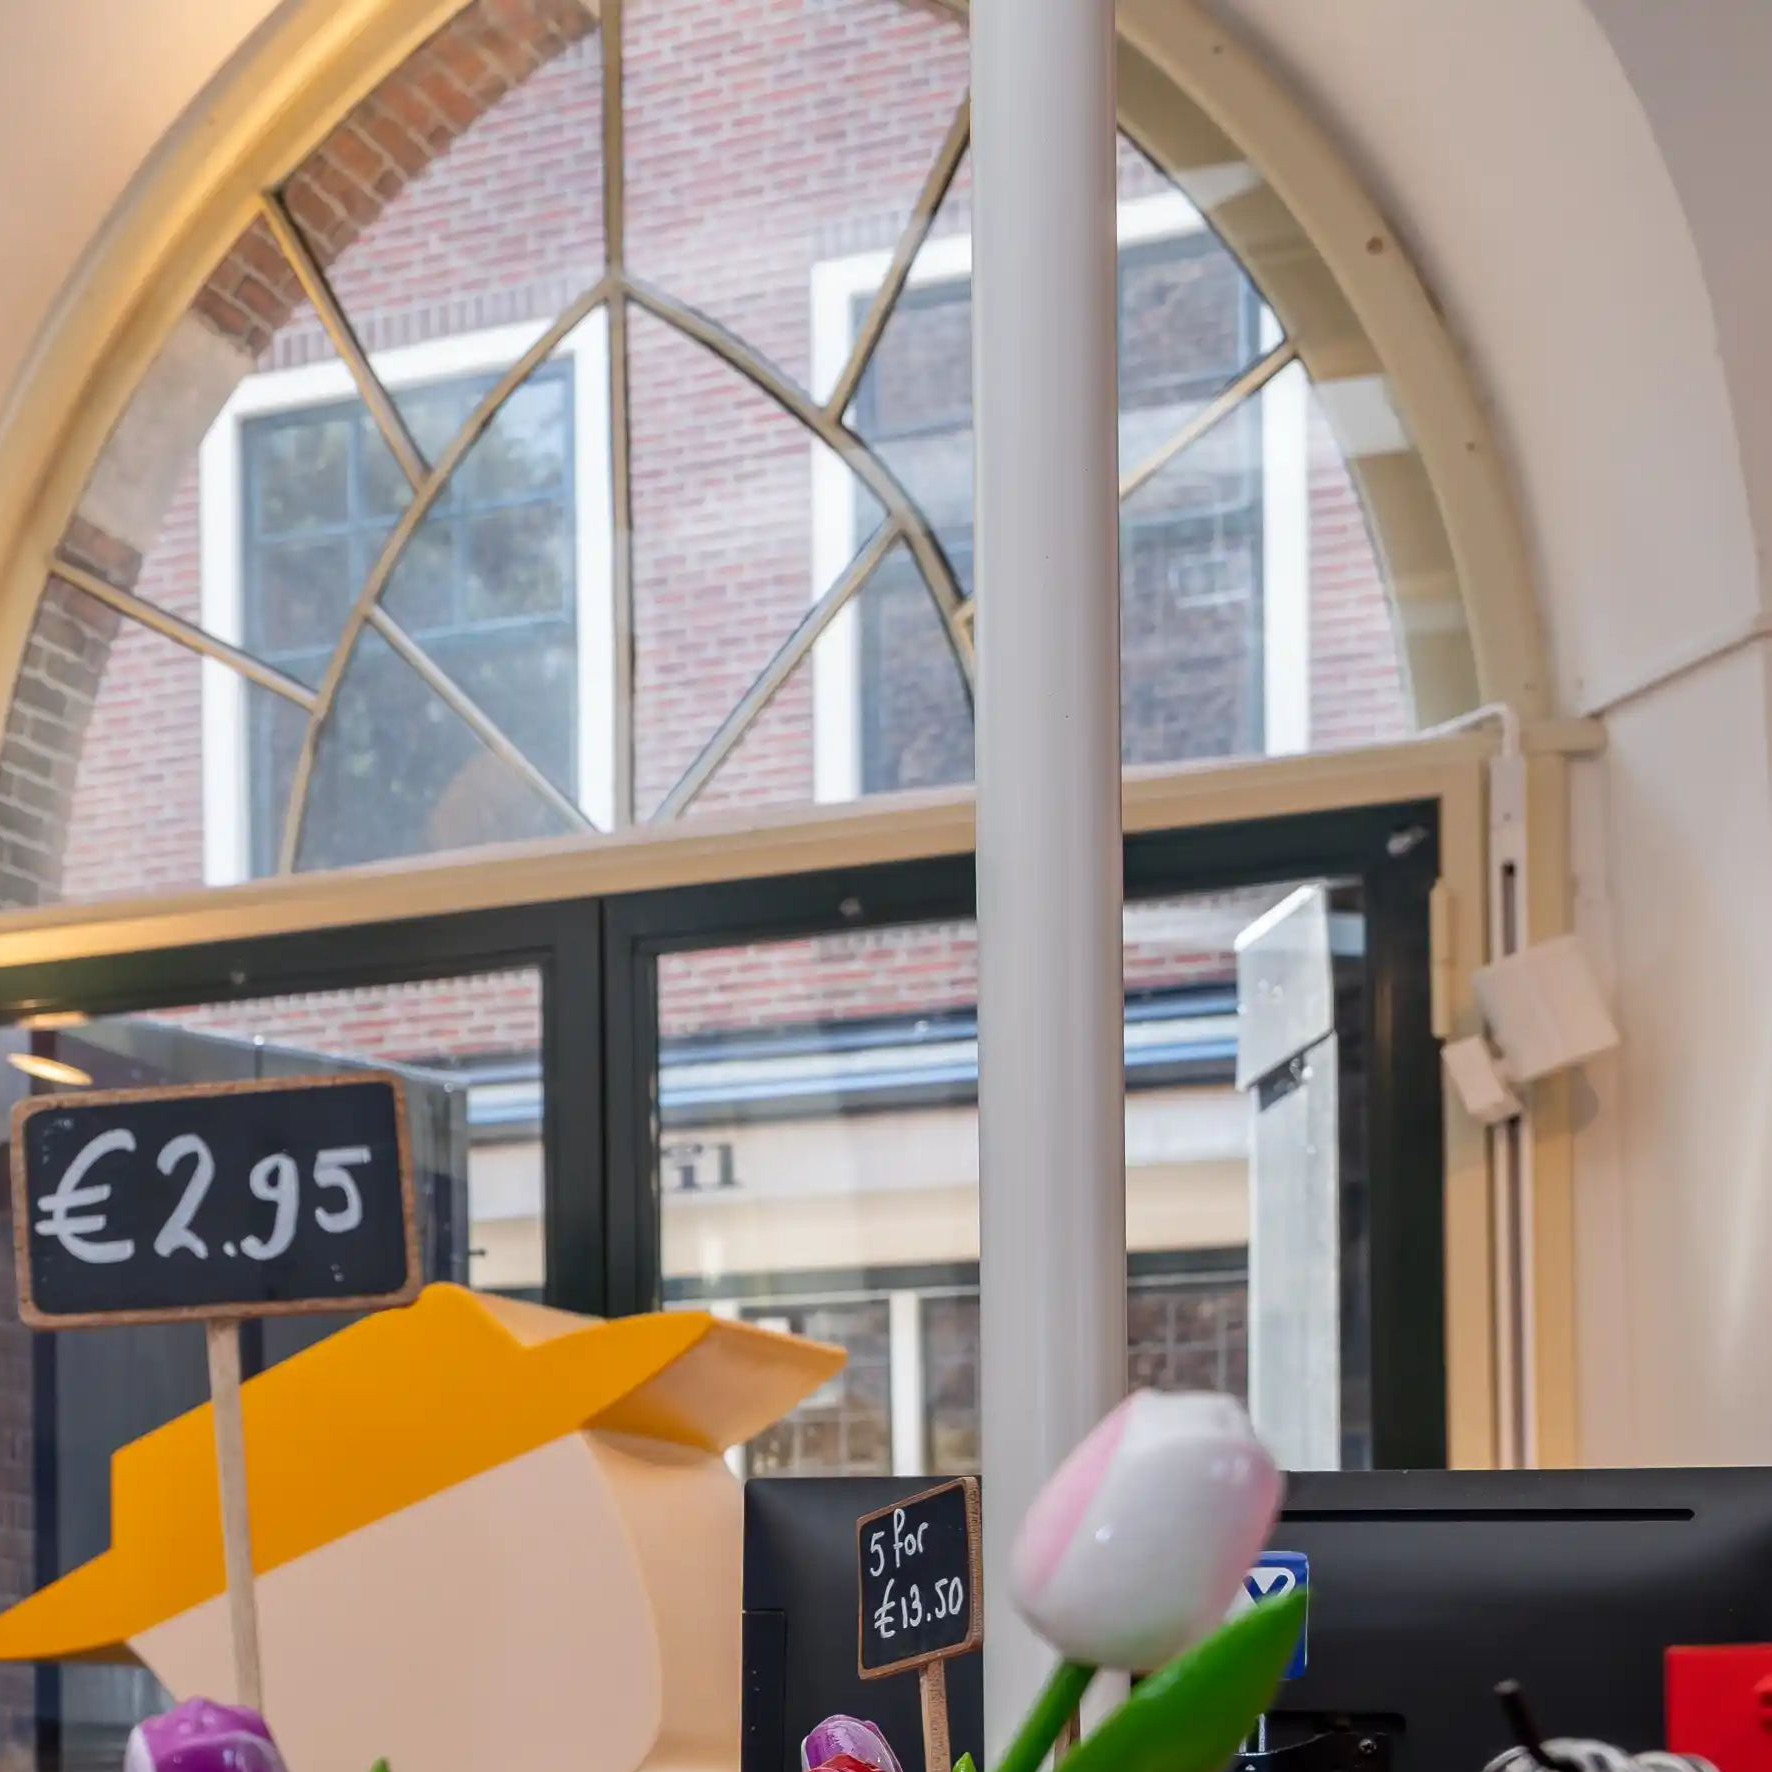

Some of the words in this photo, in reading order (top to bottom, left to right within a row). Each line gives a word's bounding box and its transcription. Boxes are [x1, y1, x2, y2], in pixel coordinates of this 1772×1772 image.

[34, 1128, 371, 1264] €2.95
[869, 1531, 886, 1577] 5
[874, 1577, 964, 1639] €13.50
